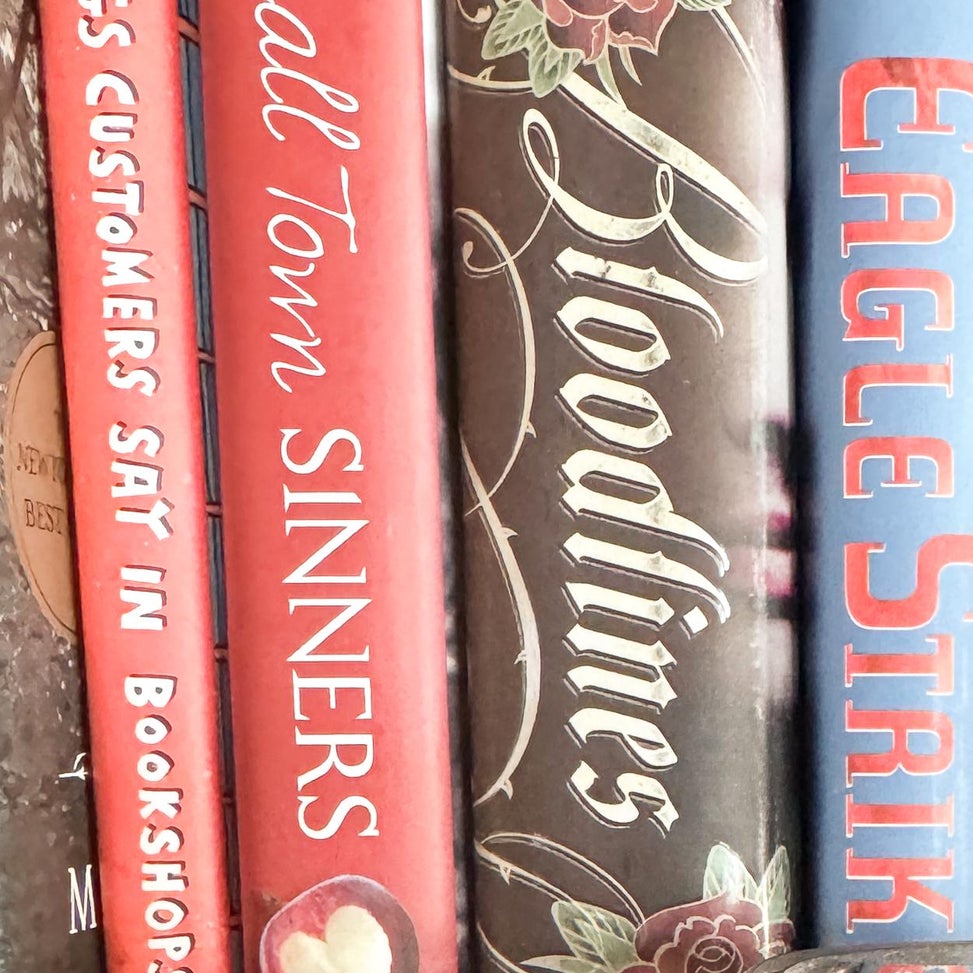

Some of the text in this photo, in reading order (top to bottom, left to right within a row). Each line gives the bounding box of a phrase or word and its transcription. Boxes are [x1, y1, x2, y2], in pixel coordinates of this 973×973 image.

[85, 69, 161, 397] CUSTOMERS
[108, 421, 173, 540] SAY
[254, 0, 380, 840] all Town SINNERS
[520, 72, 768, 838] Bloodlines
[119, 564, 168, 631] IN
